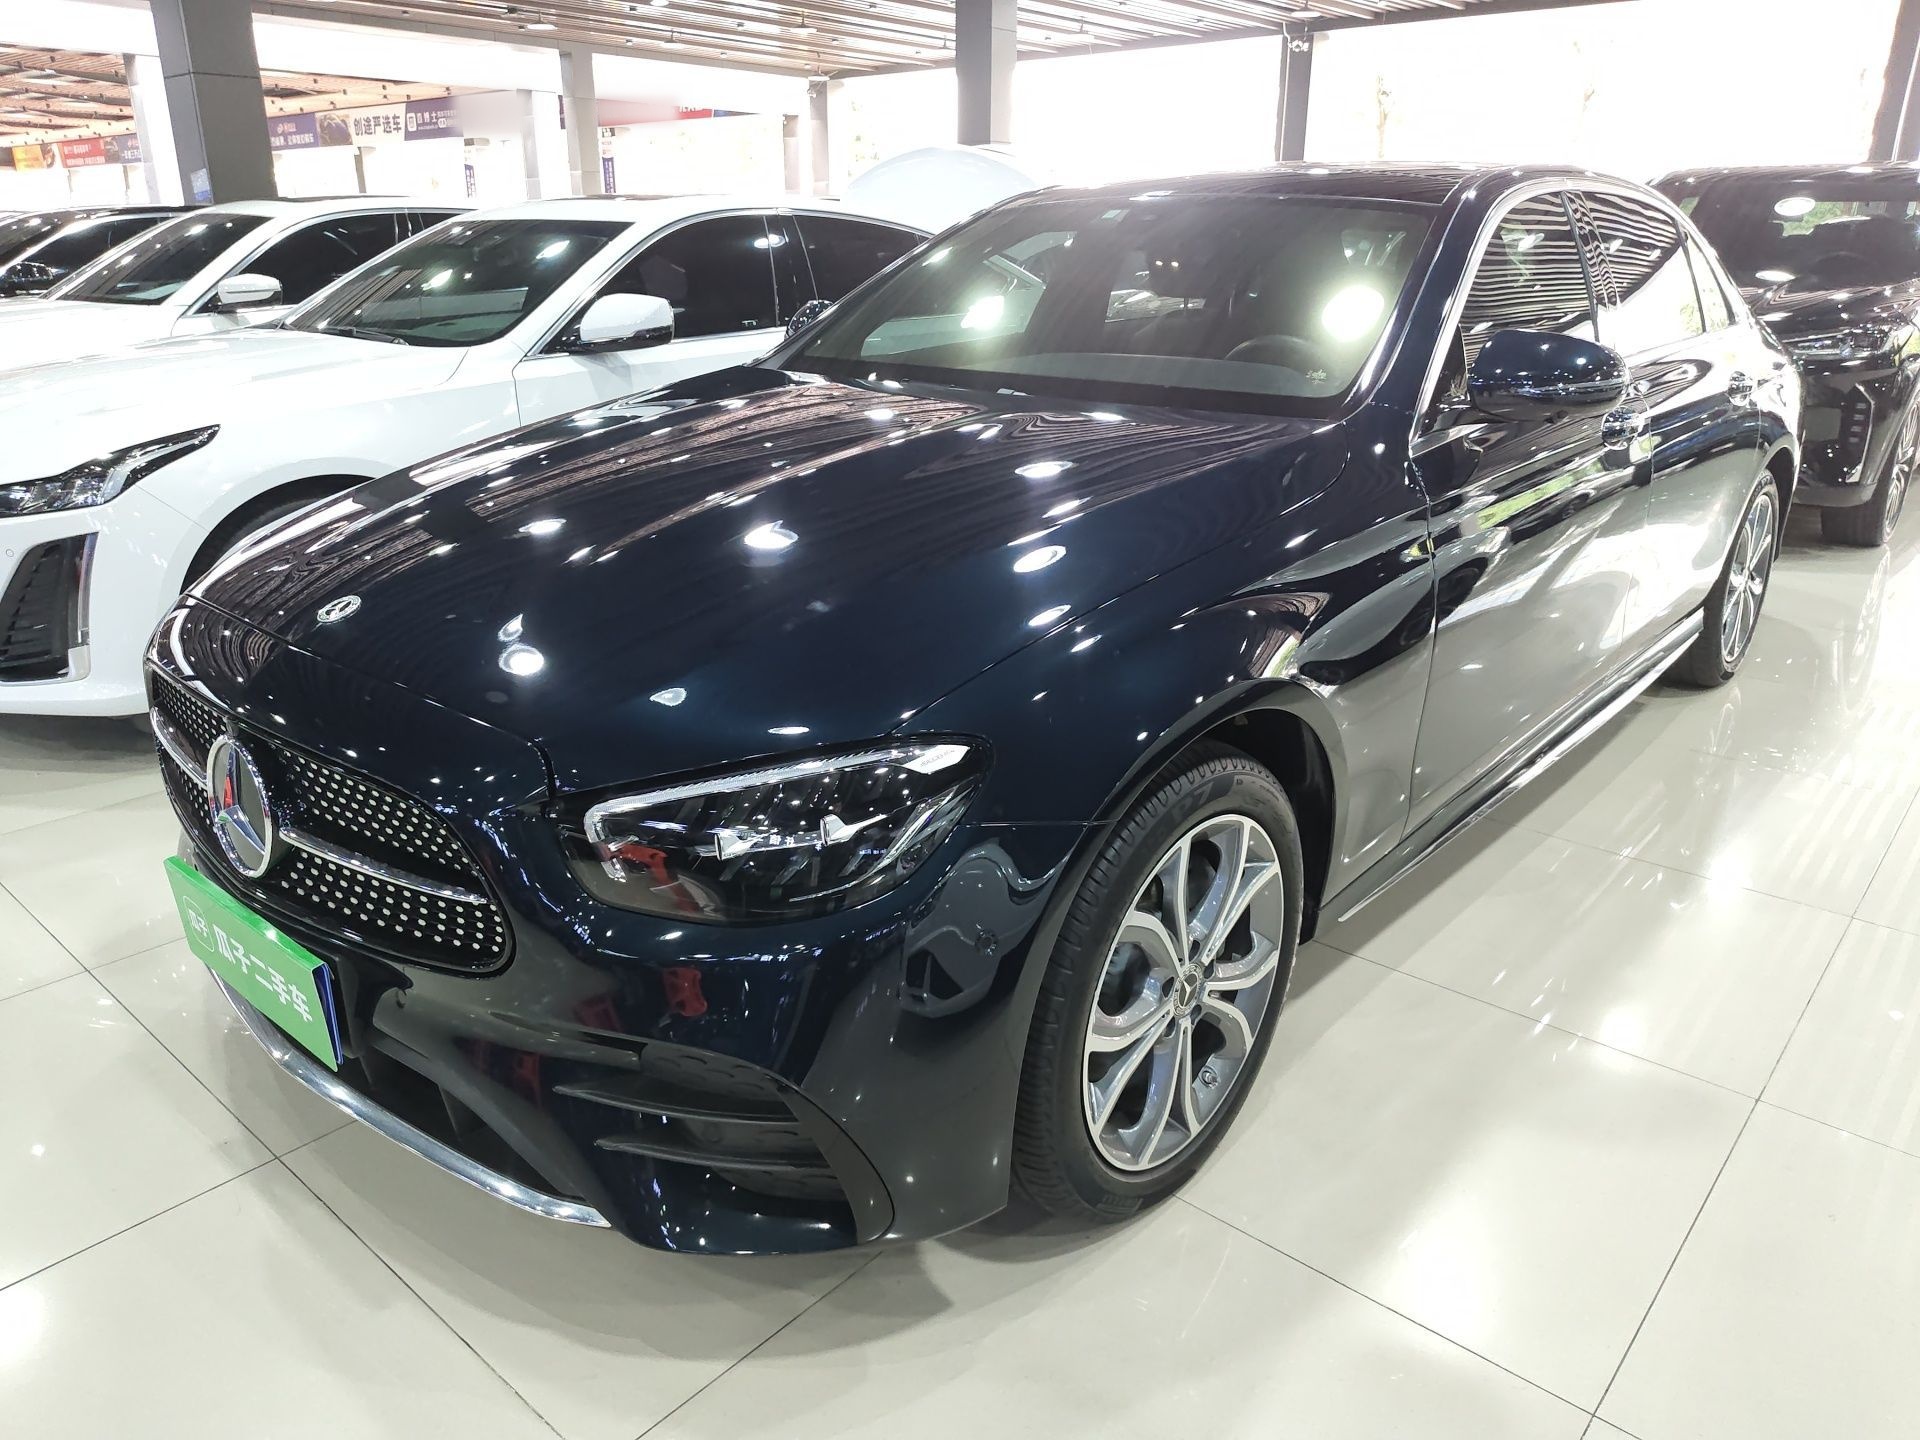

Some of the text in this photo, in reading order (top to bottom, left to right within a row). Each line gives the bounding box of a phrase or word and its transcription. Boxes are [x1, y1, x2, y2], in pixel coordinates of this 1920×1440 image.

[353, 113, 402, 136] 创途严选车
[189, 909, 208, 937] 瓜子
[212, 924, 313, 1022] 瓜子二手车
